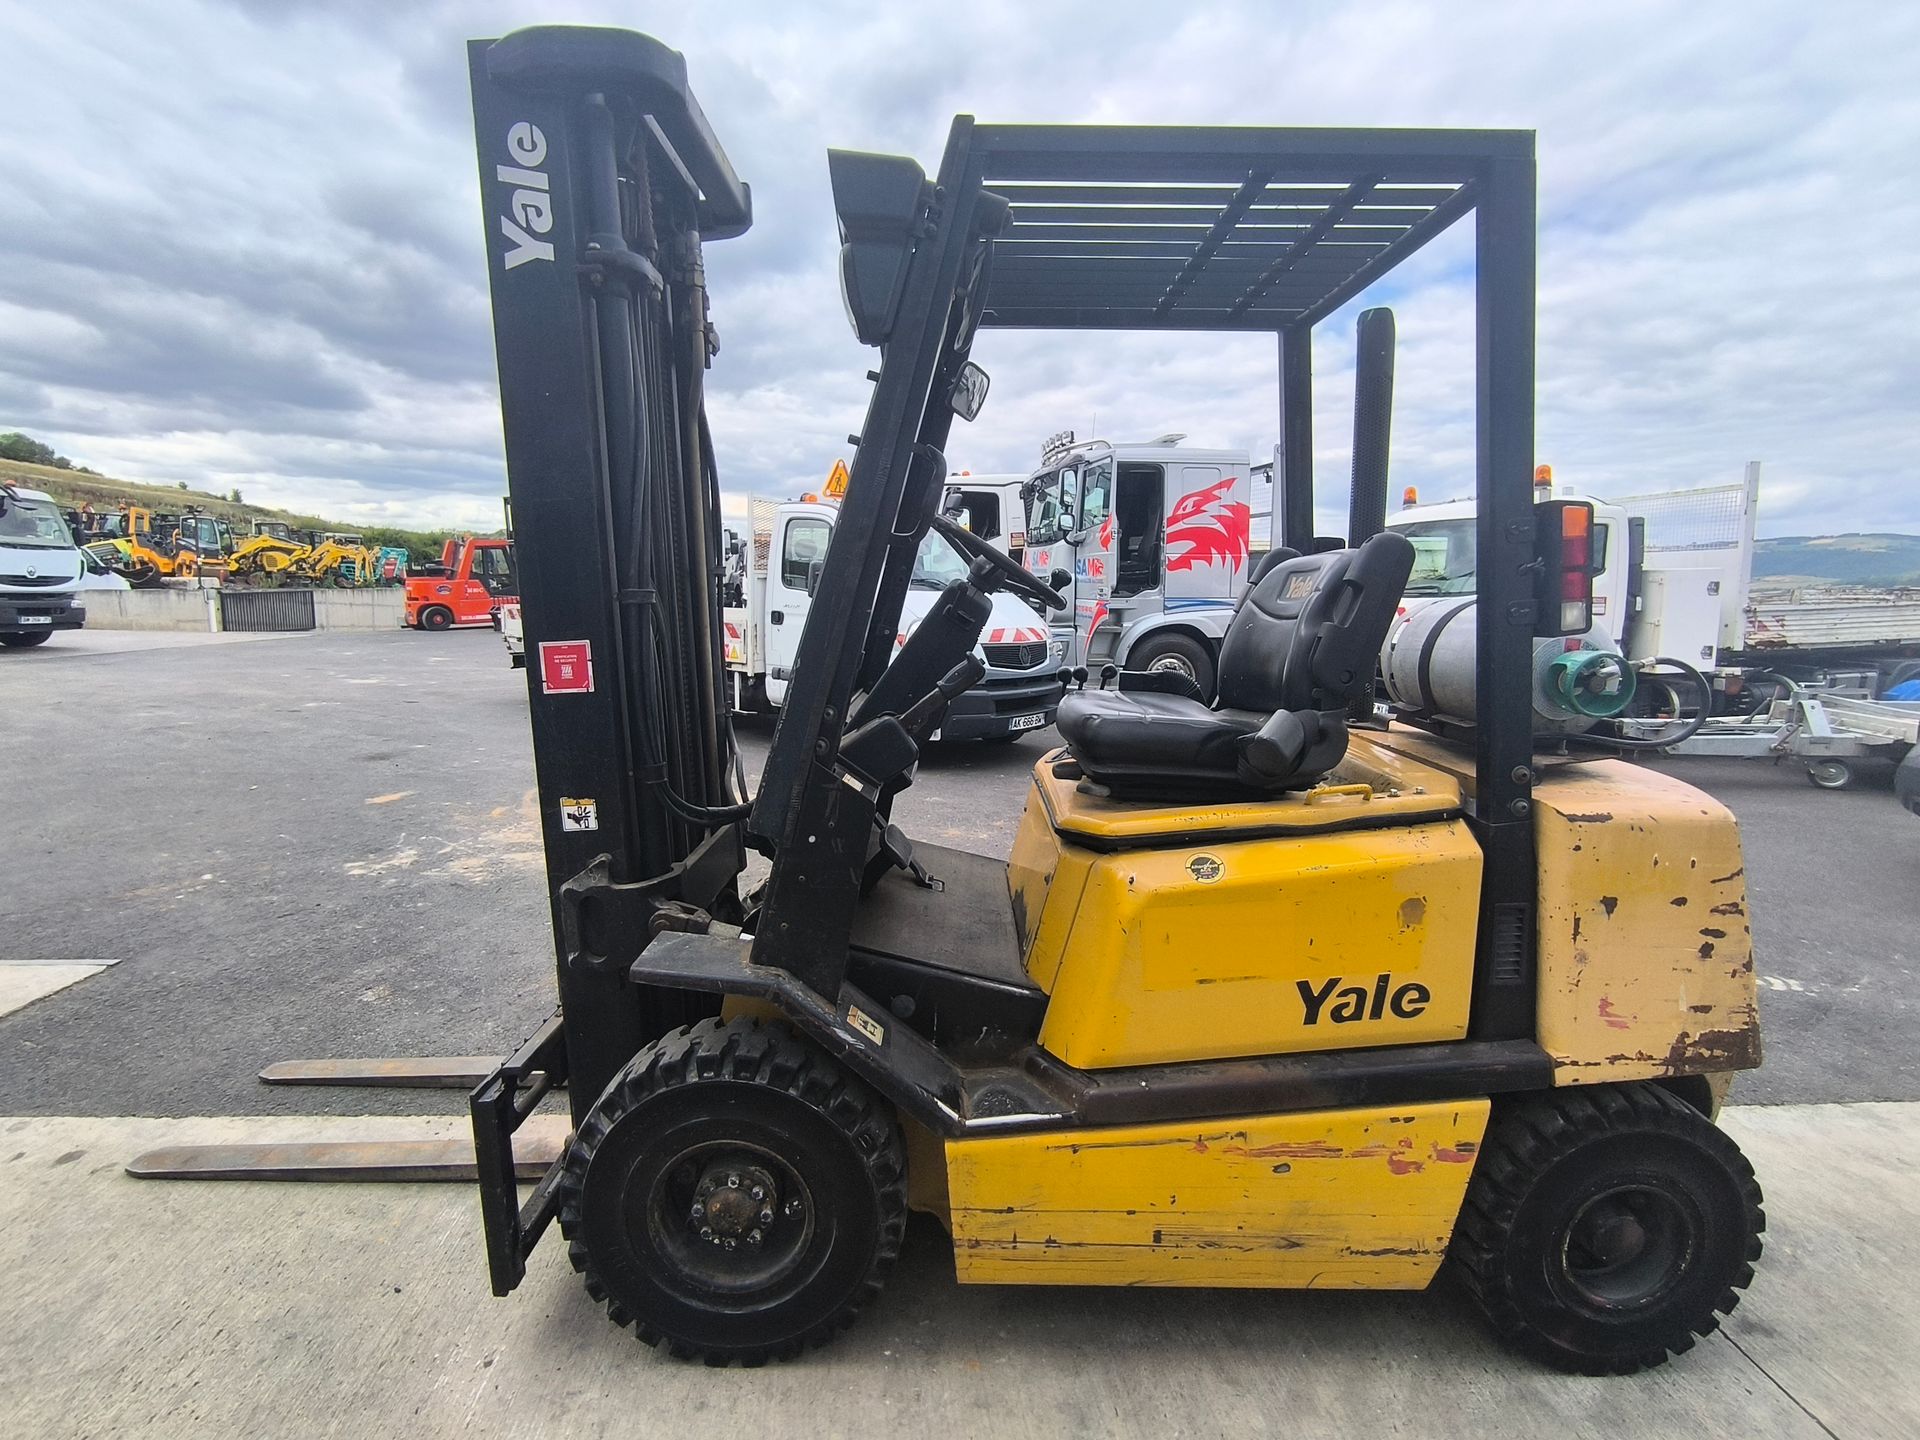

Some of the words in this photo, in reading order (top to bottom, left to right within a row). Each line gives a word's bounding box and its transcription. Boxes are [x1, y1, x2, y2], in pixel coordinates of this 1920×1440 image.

[496, 121, 556, 271] Yale
[1286, 576, 1313, 599] Yale
[1295, 973, 1431, 1026] Yale
